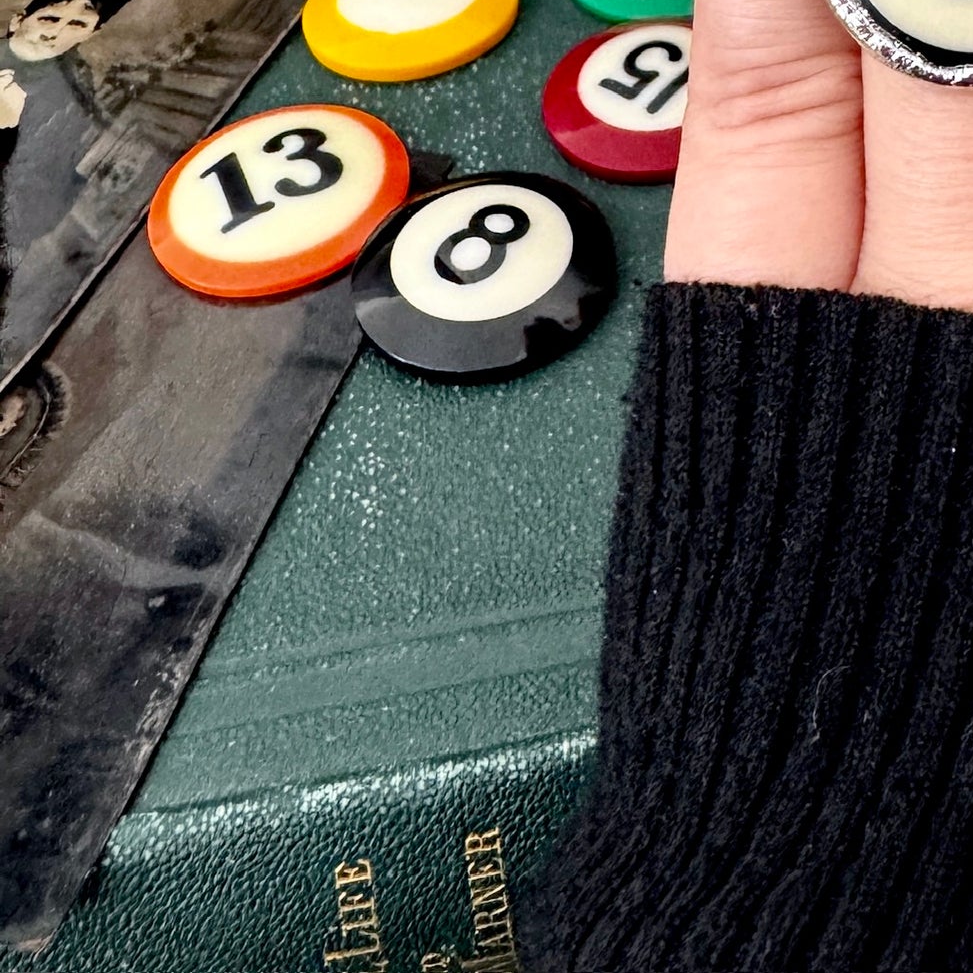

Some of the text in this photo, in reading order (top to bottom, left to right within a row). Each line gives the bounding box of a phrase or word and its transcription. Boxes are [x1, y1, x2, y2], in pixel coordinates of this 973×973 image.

[598, 40, 689, 114] 15
[199, 127, 343, 234] 13
[434, 203, 531, 285] 8
[323, 858, 382, 966] LIFE
